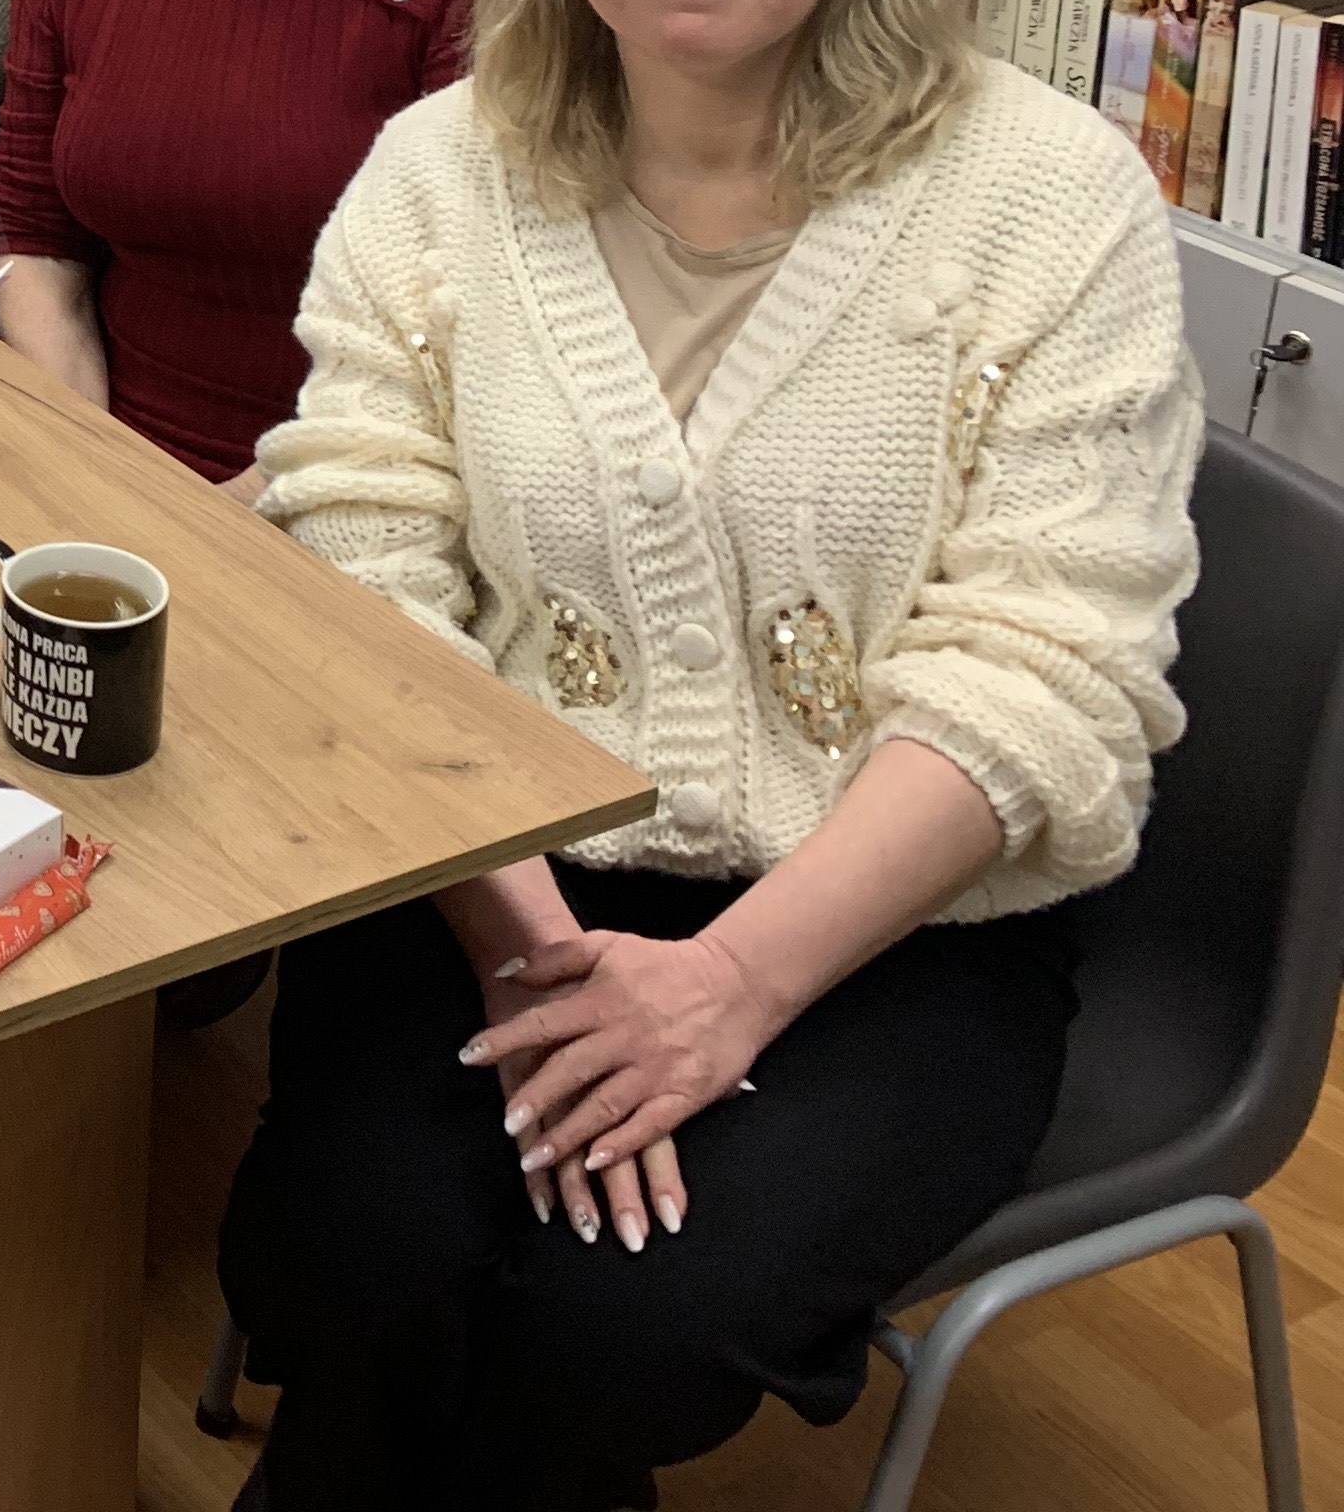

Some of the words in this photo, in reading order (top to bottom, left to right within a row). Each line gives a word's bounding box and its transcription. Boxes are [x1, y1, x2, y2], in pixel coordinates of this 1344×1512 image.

[32, 633, 88, 665] PRACA
[18, 648, 94, 698] HAŃBI
[18, 679, 88, 724] KAŻDA
